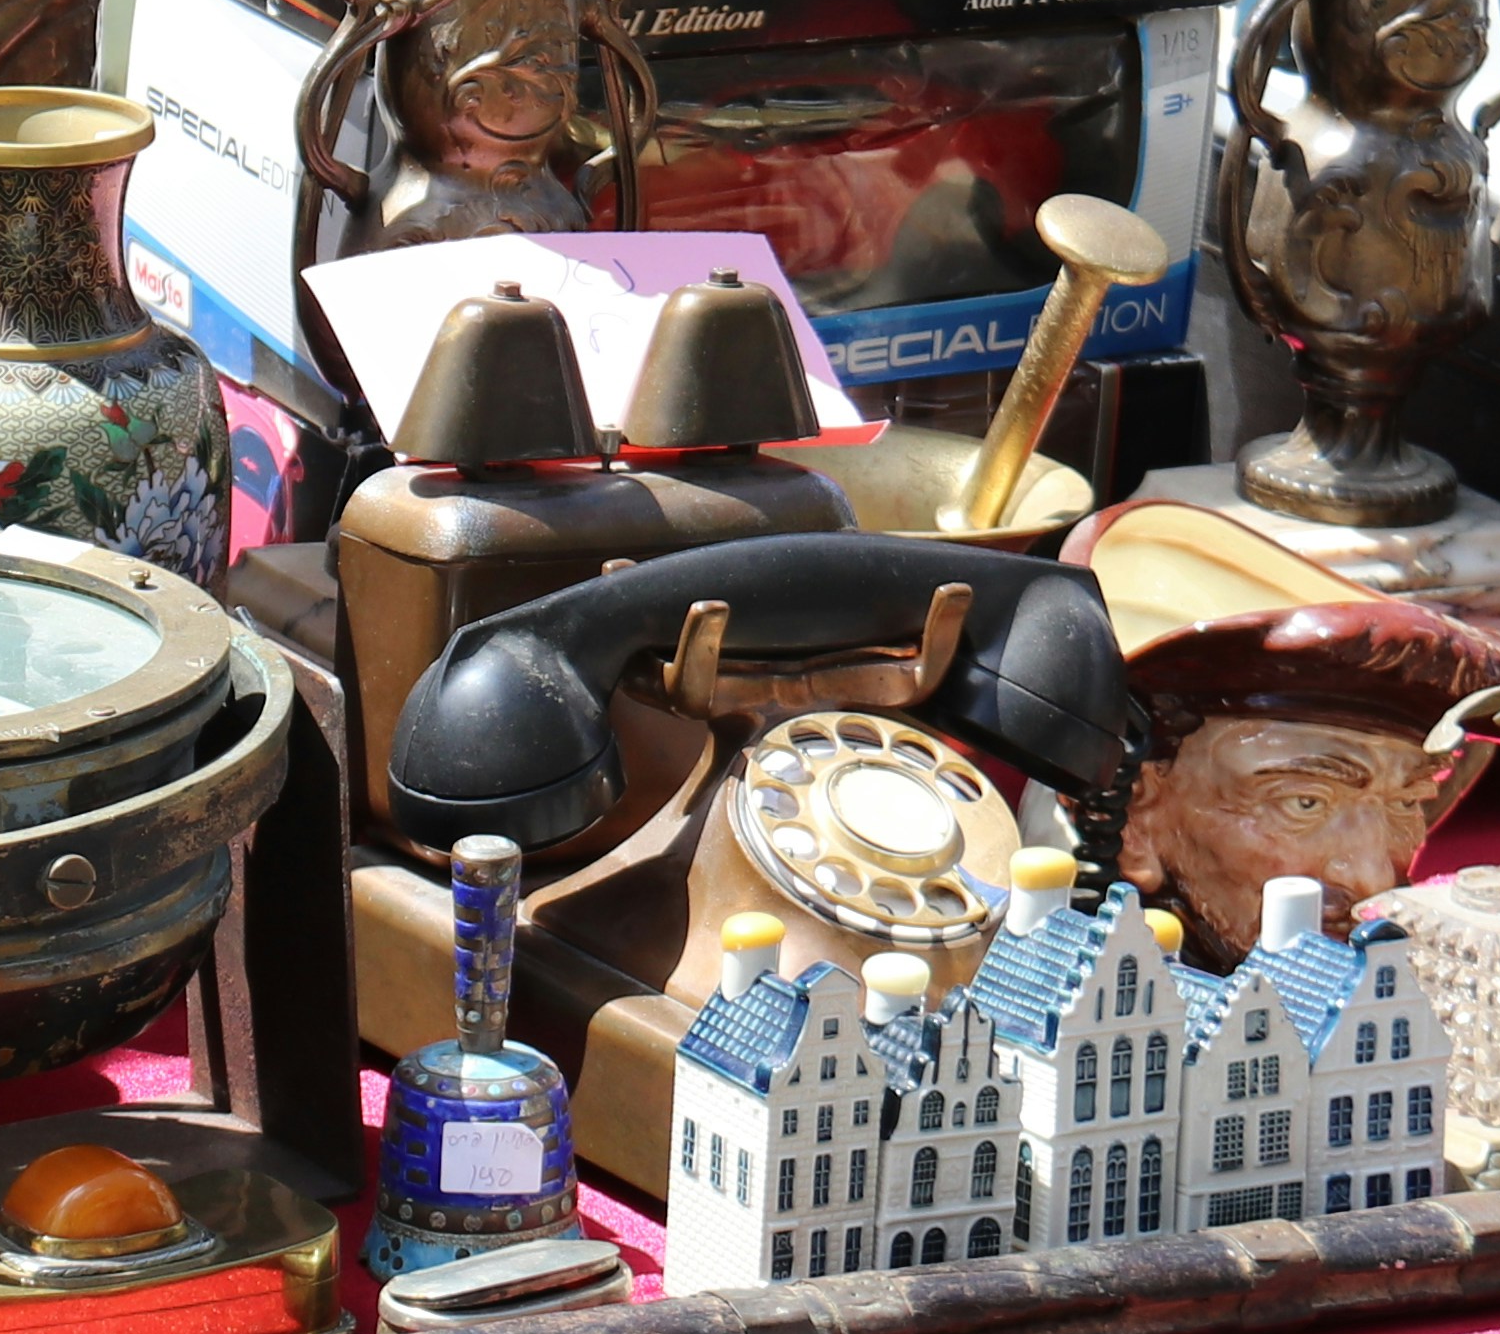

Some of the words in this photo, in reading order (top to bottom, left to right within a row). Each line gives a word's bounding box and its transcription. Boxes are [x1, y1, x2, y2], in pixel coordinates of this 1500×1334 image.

[645, 4, 766, 37] Edition
[1161, 27, 1199, 58] 1/18
[1162, 92, 1194, 116] 3+
[145, 86, 260, 179] SPECIAL
[134, 257, 184, 309] Maisto
[824, 319, 1025, 375] PECIAL
